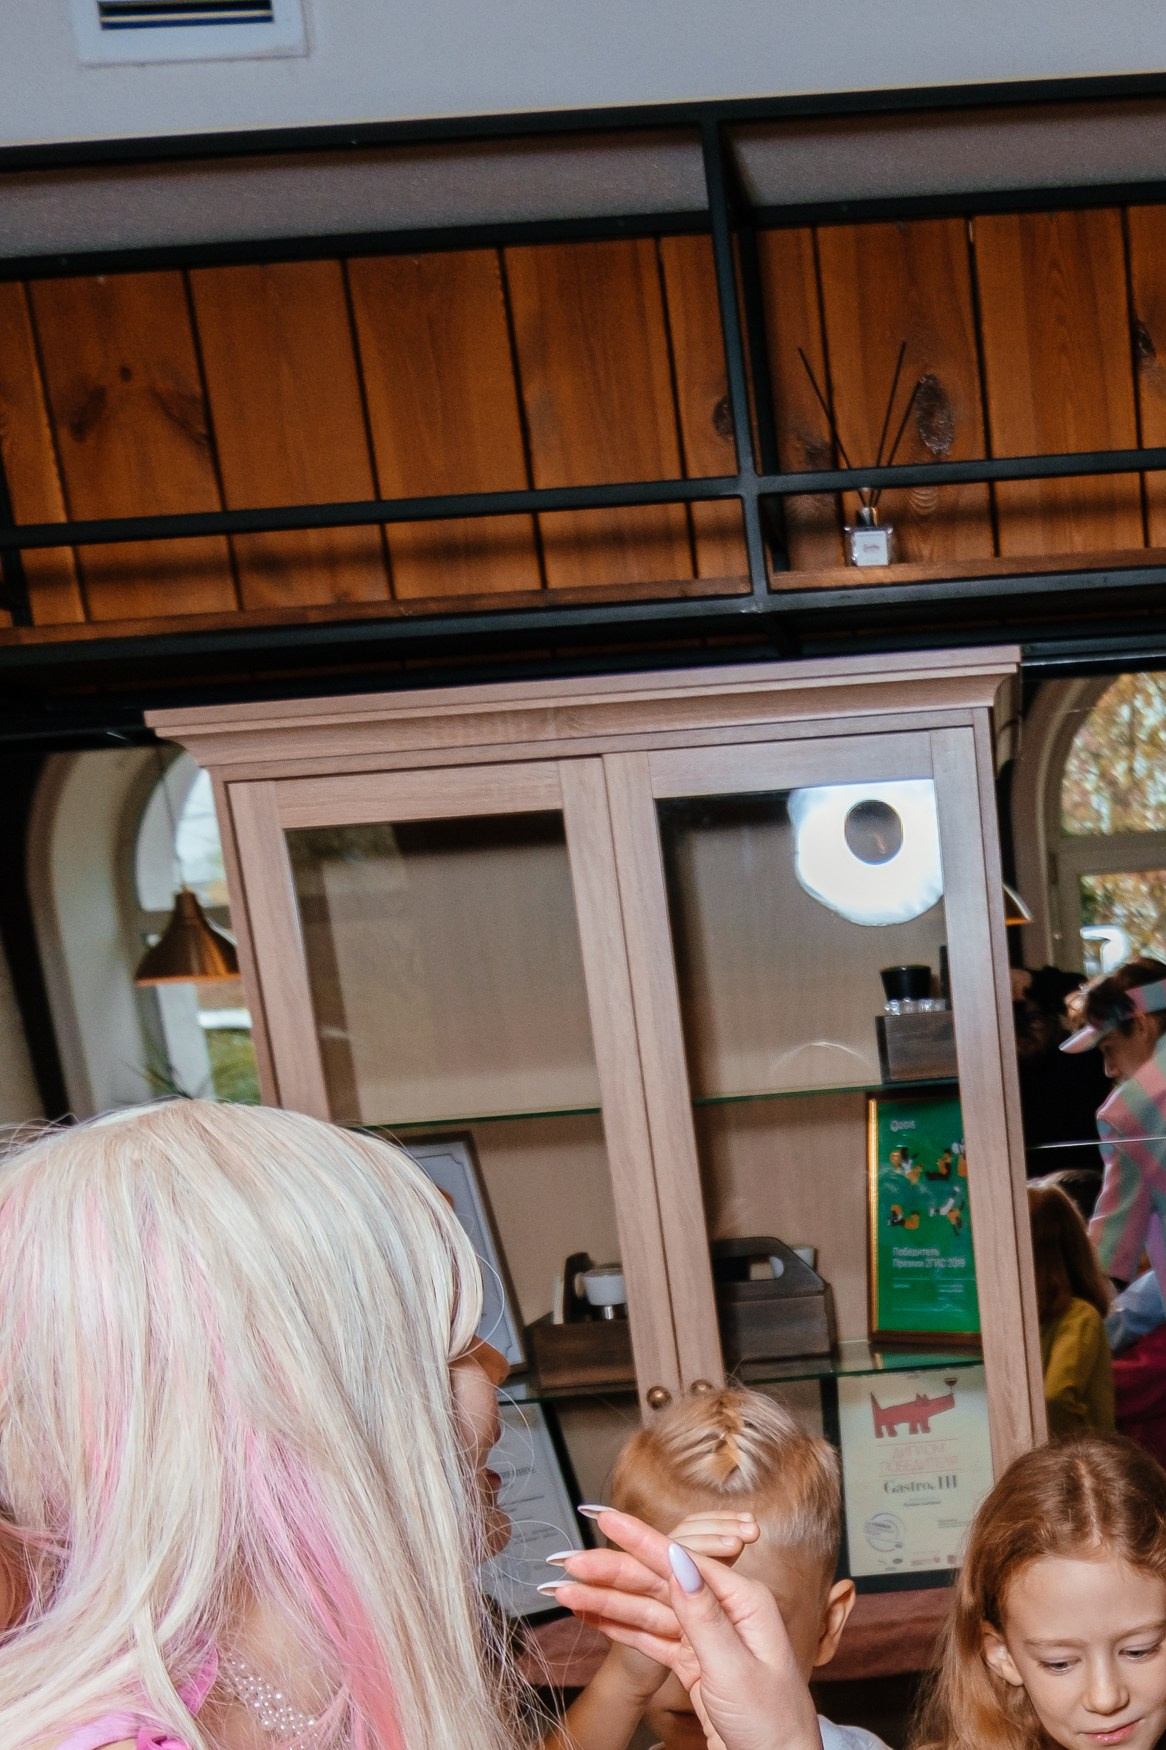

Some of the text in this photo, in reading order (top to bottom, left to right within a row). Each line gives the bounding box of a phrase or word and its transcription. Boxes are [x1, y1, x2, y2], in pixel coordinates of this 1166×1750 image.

[893, 1247, 940, 1257] Победитель
[893, 1259, 924, 1269] Премии
[947, 1257, 966, 1268] 2019
